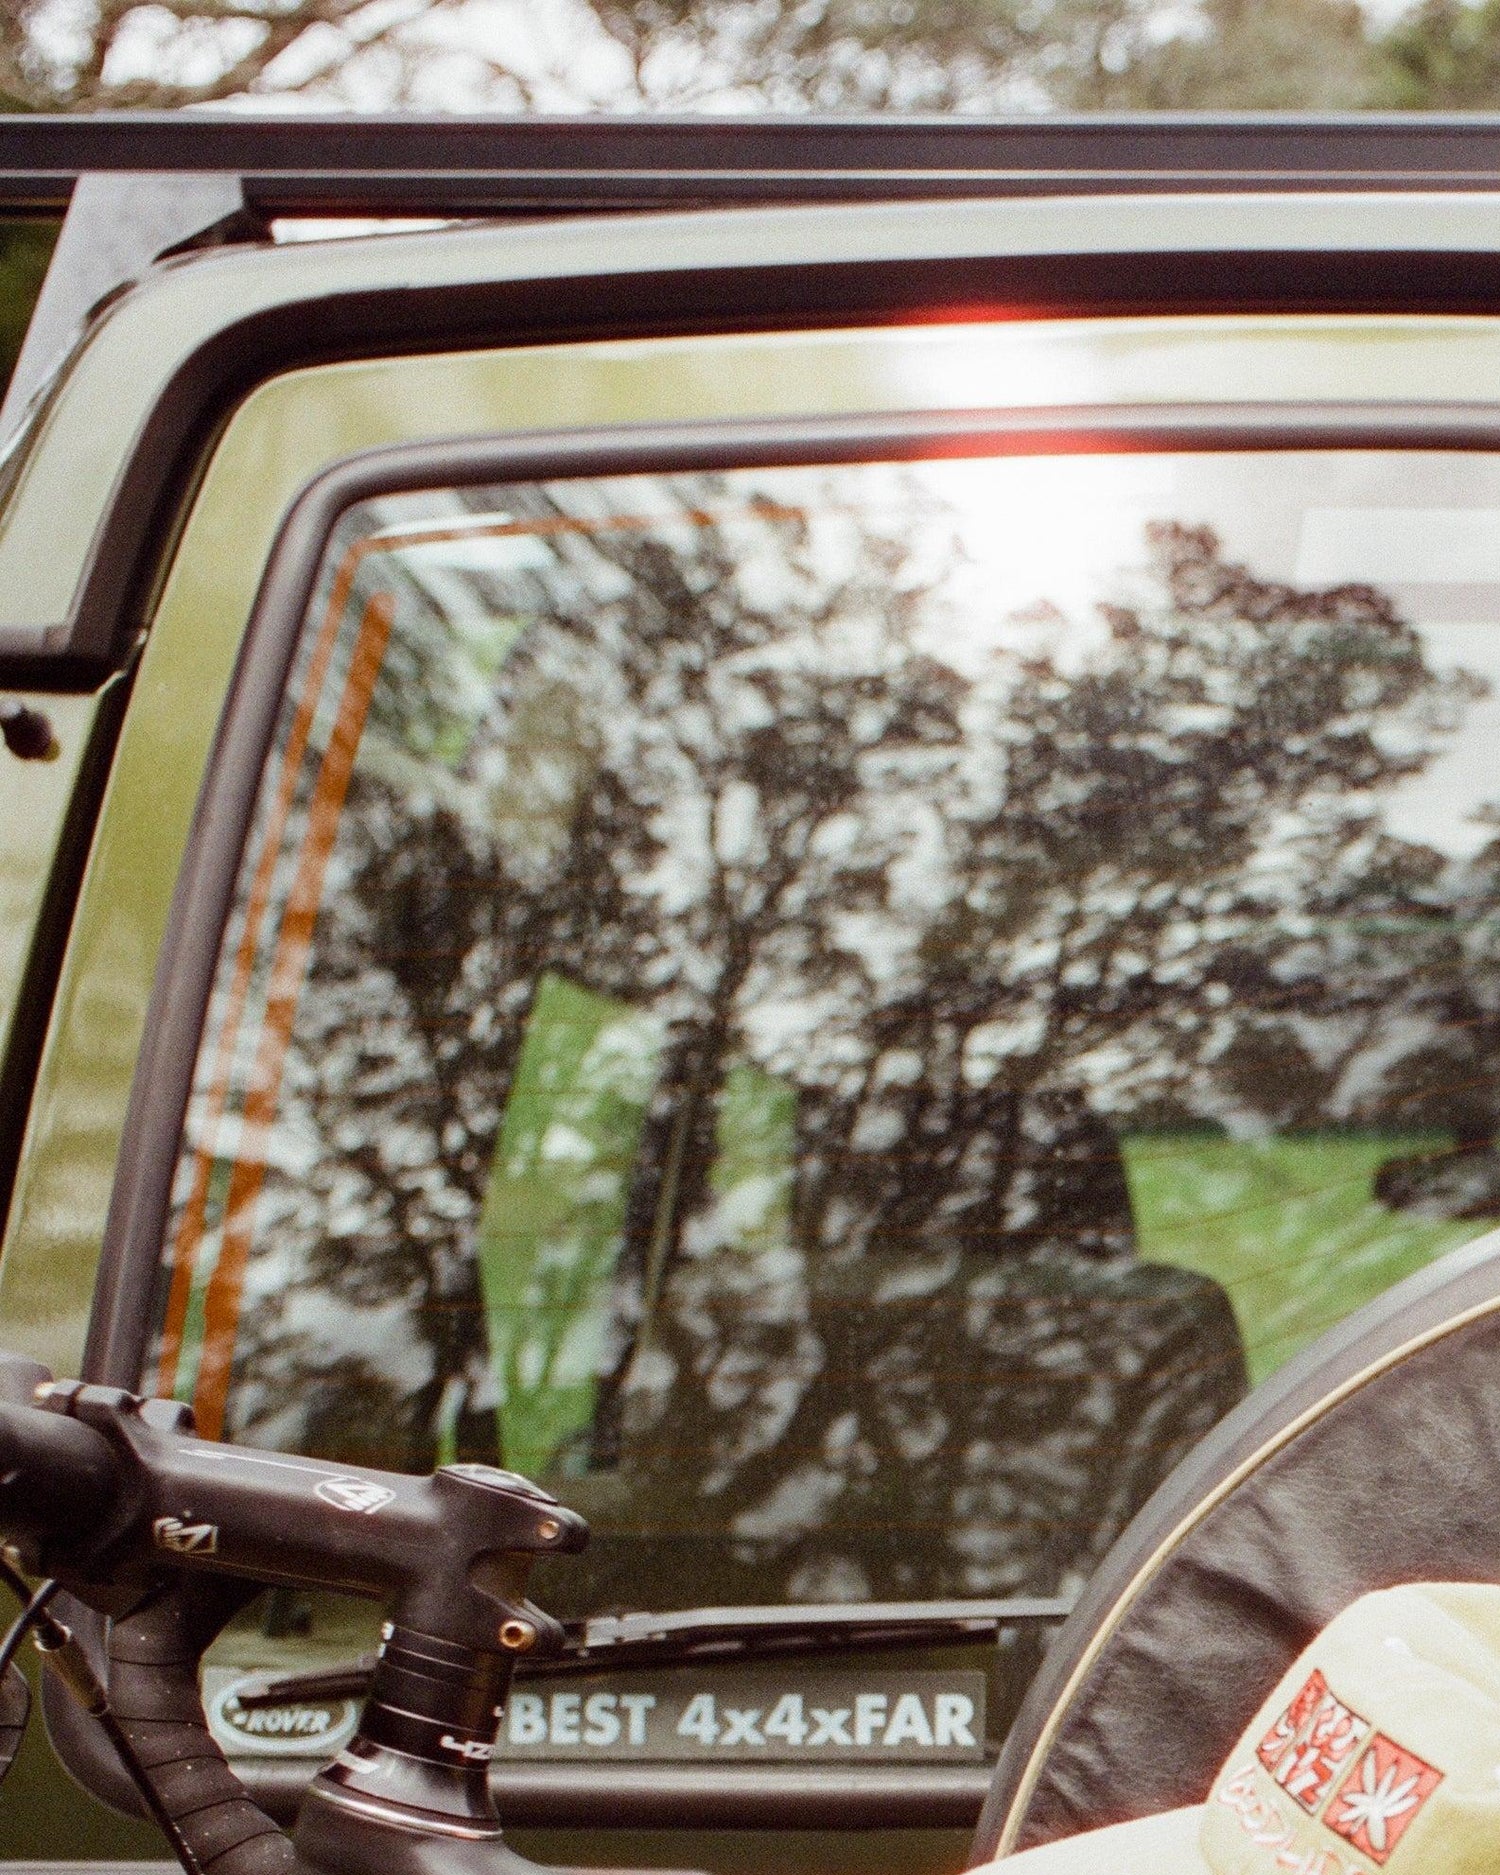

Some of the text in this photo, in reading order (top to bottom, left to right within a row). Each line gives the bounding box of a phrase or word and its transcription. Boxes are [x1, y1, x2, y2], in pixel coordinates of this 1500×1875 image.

[246, 1708, 332, 1734] ROVER
[507, 1692, 977, 1748] BEST 4x4xFAR
